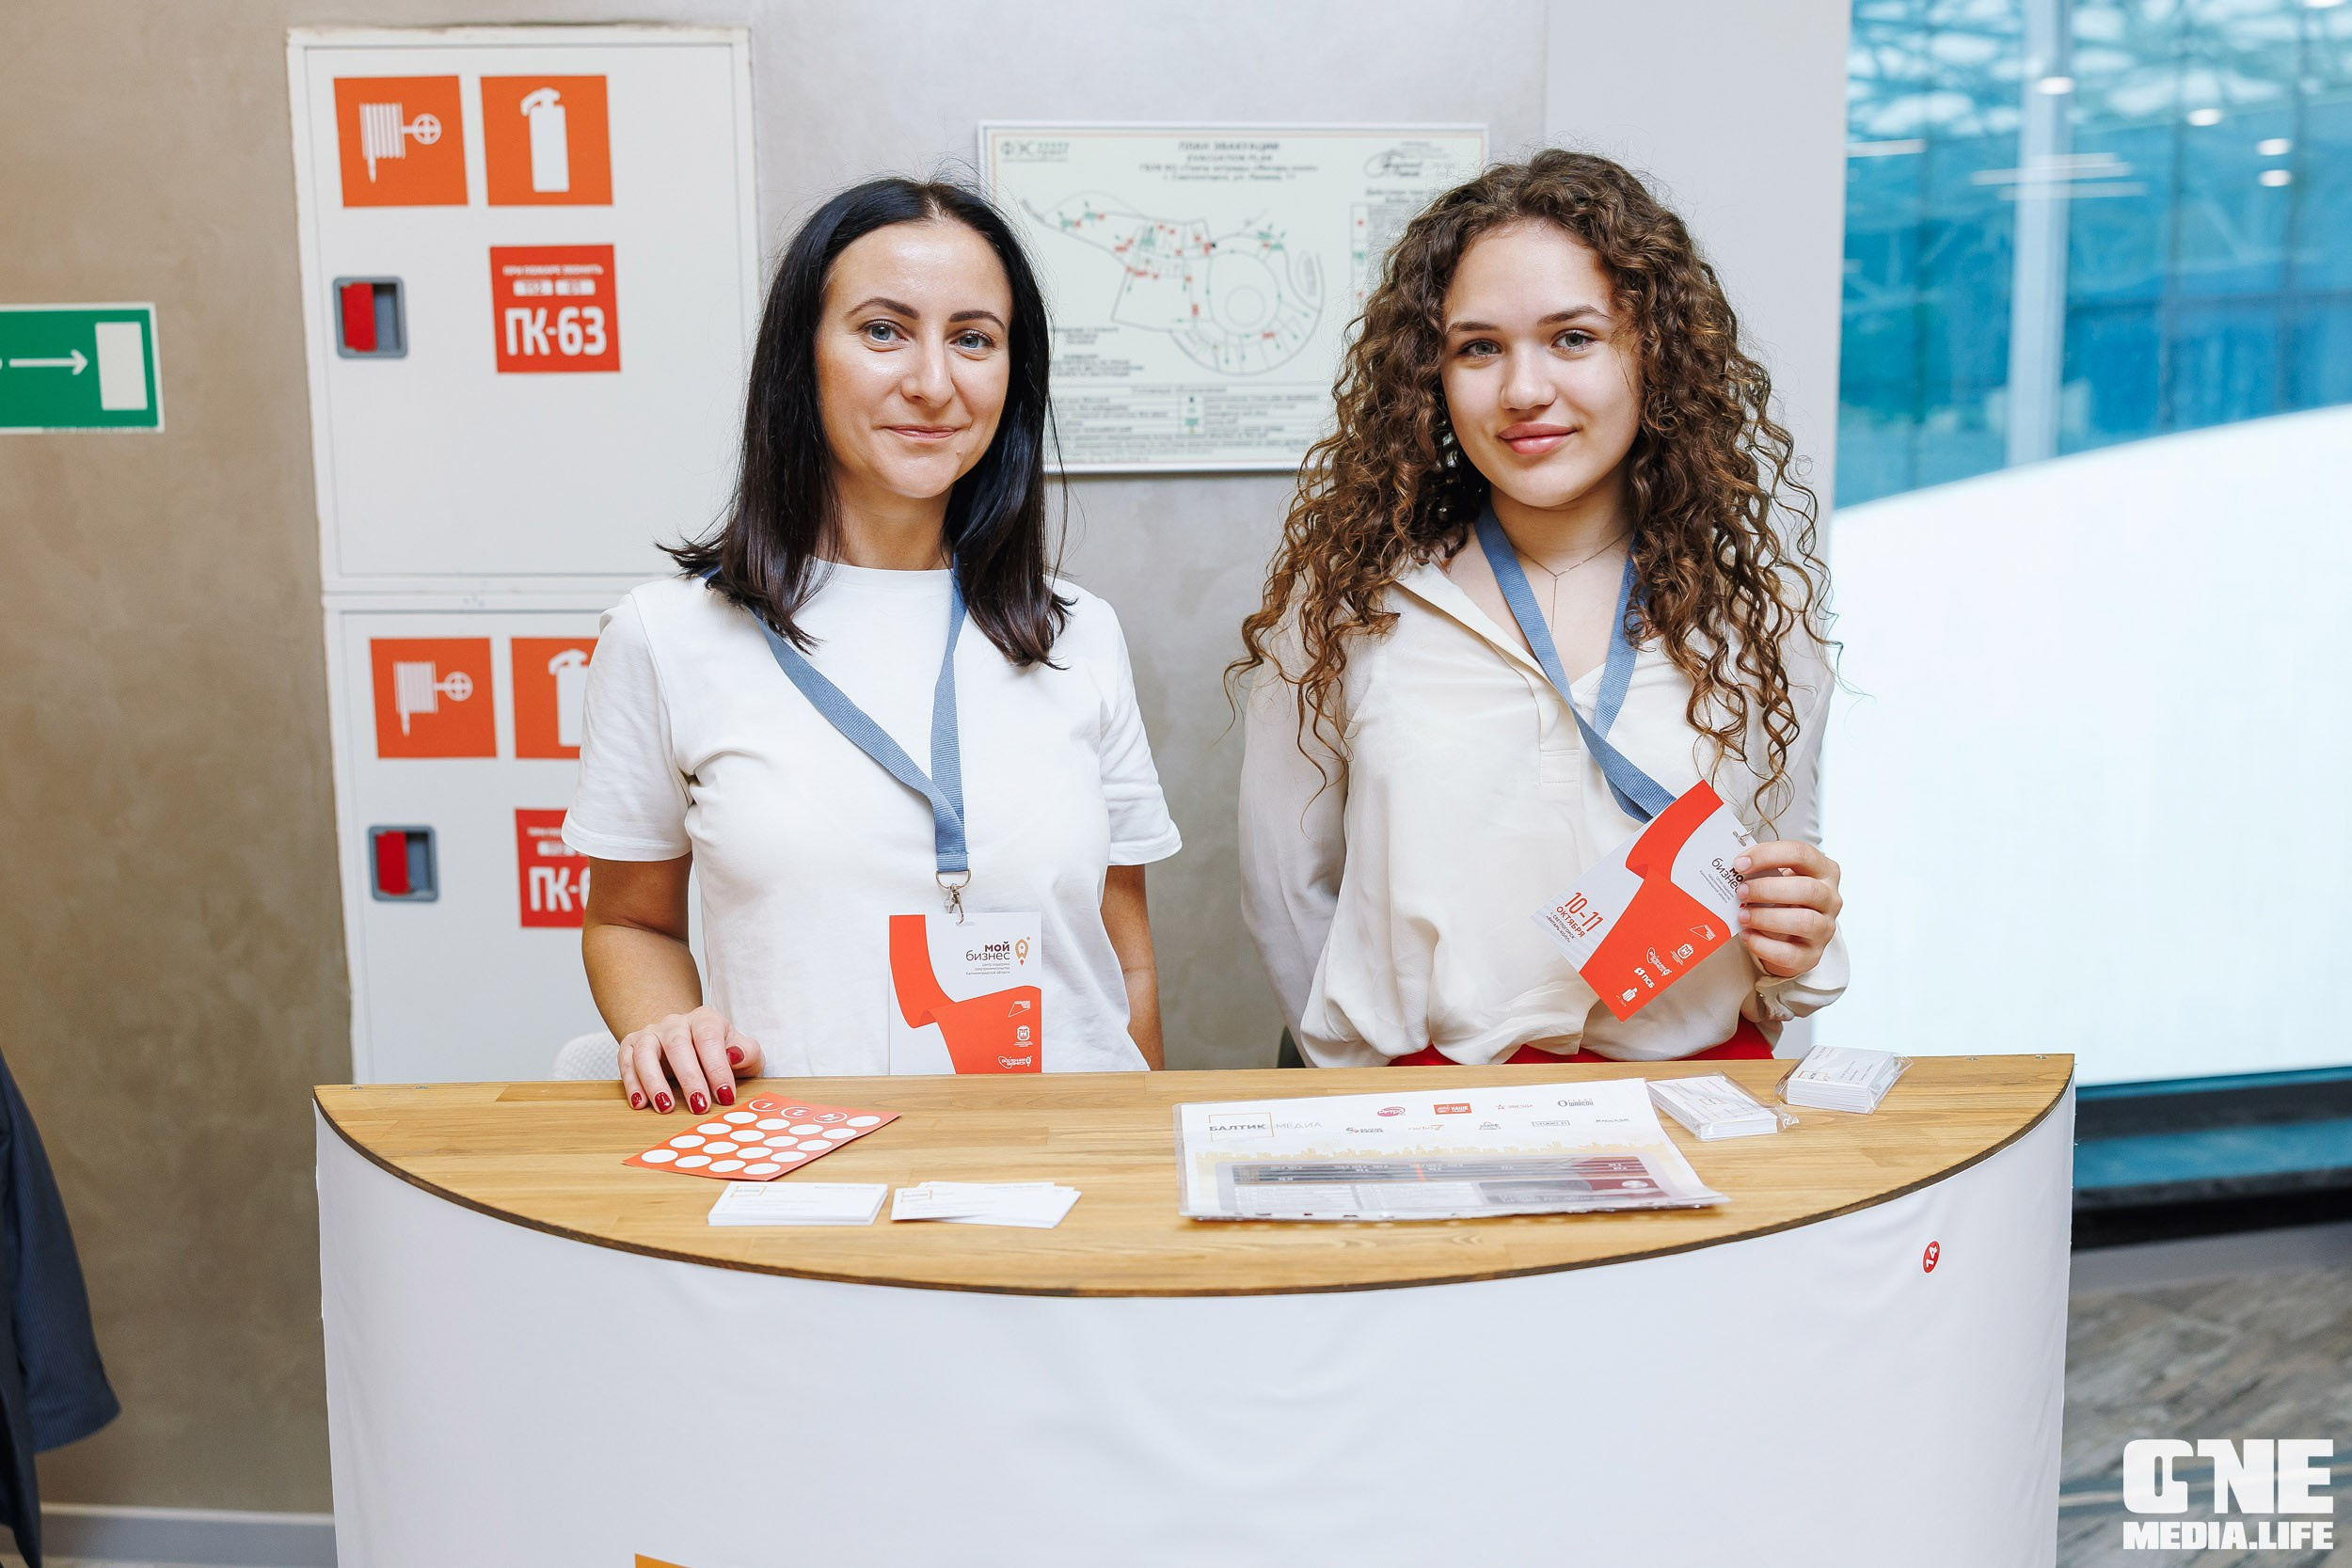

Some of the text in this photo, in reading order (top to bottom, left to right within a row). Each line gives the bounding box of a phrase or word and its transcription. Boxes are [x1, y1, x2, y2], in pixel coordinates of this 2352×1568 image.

[504, 305, 608, 356] ПК-63
[1729, 867, 1745, 884] мо
[1556, 905, 1585, 938] ОКТЯБРЯ
[984, 941, 1010, 952] мой
[965, 950, 1010, 961] бизнес
[1641, 974, 1655, 989] ПСБ
[1925, 1245, 1938, 1269] 14
